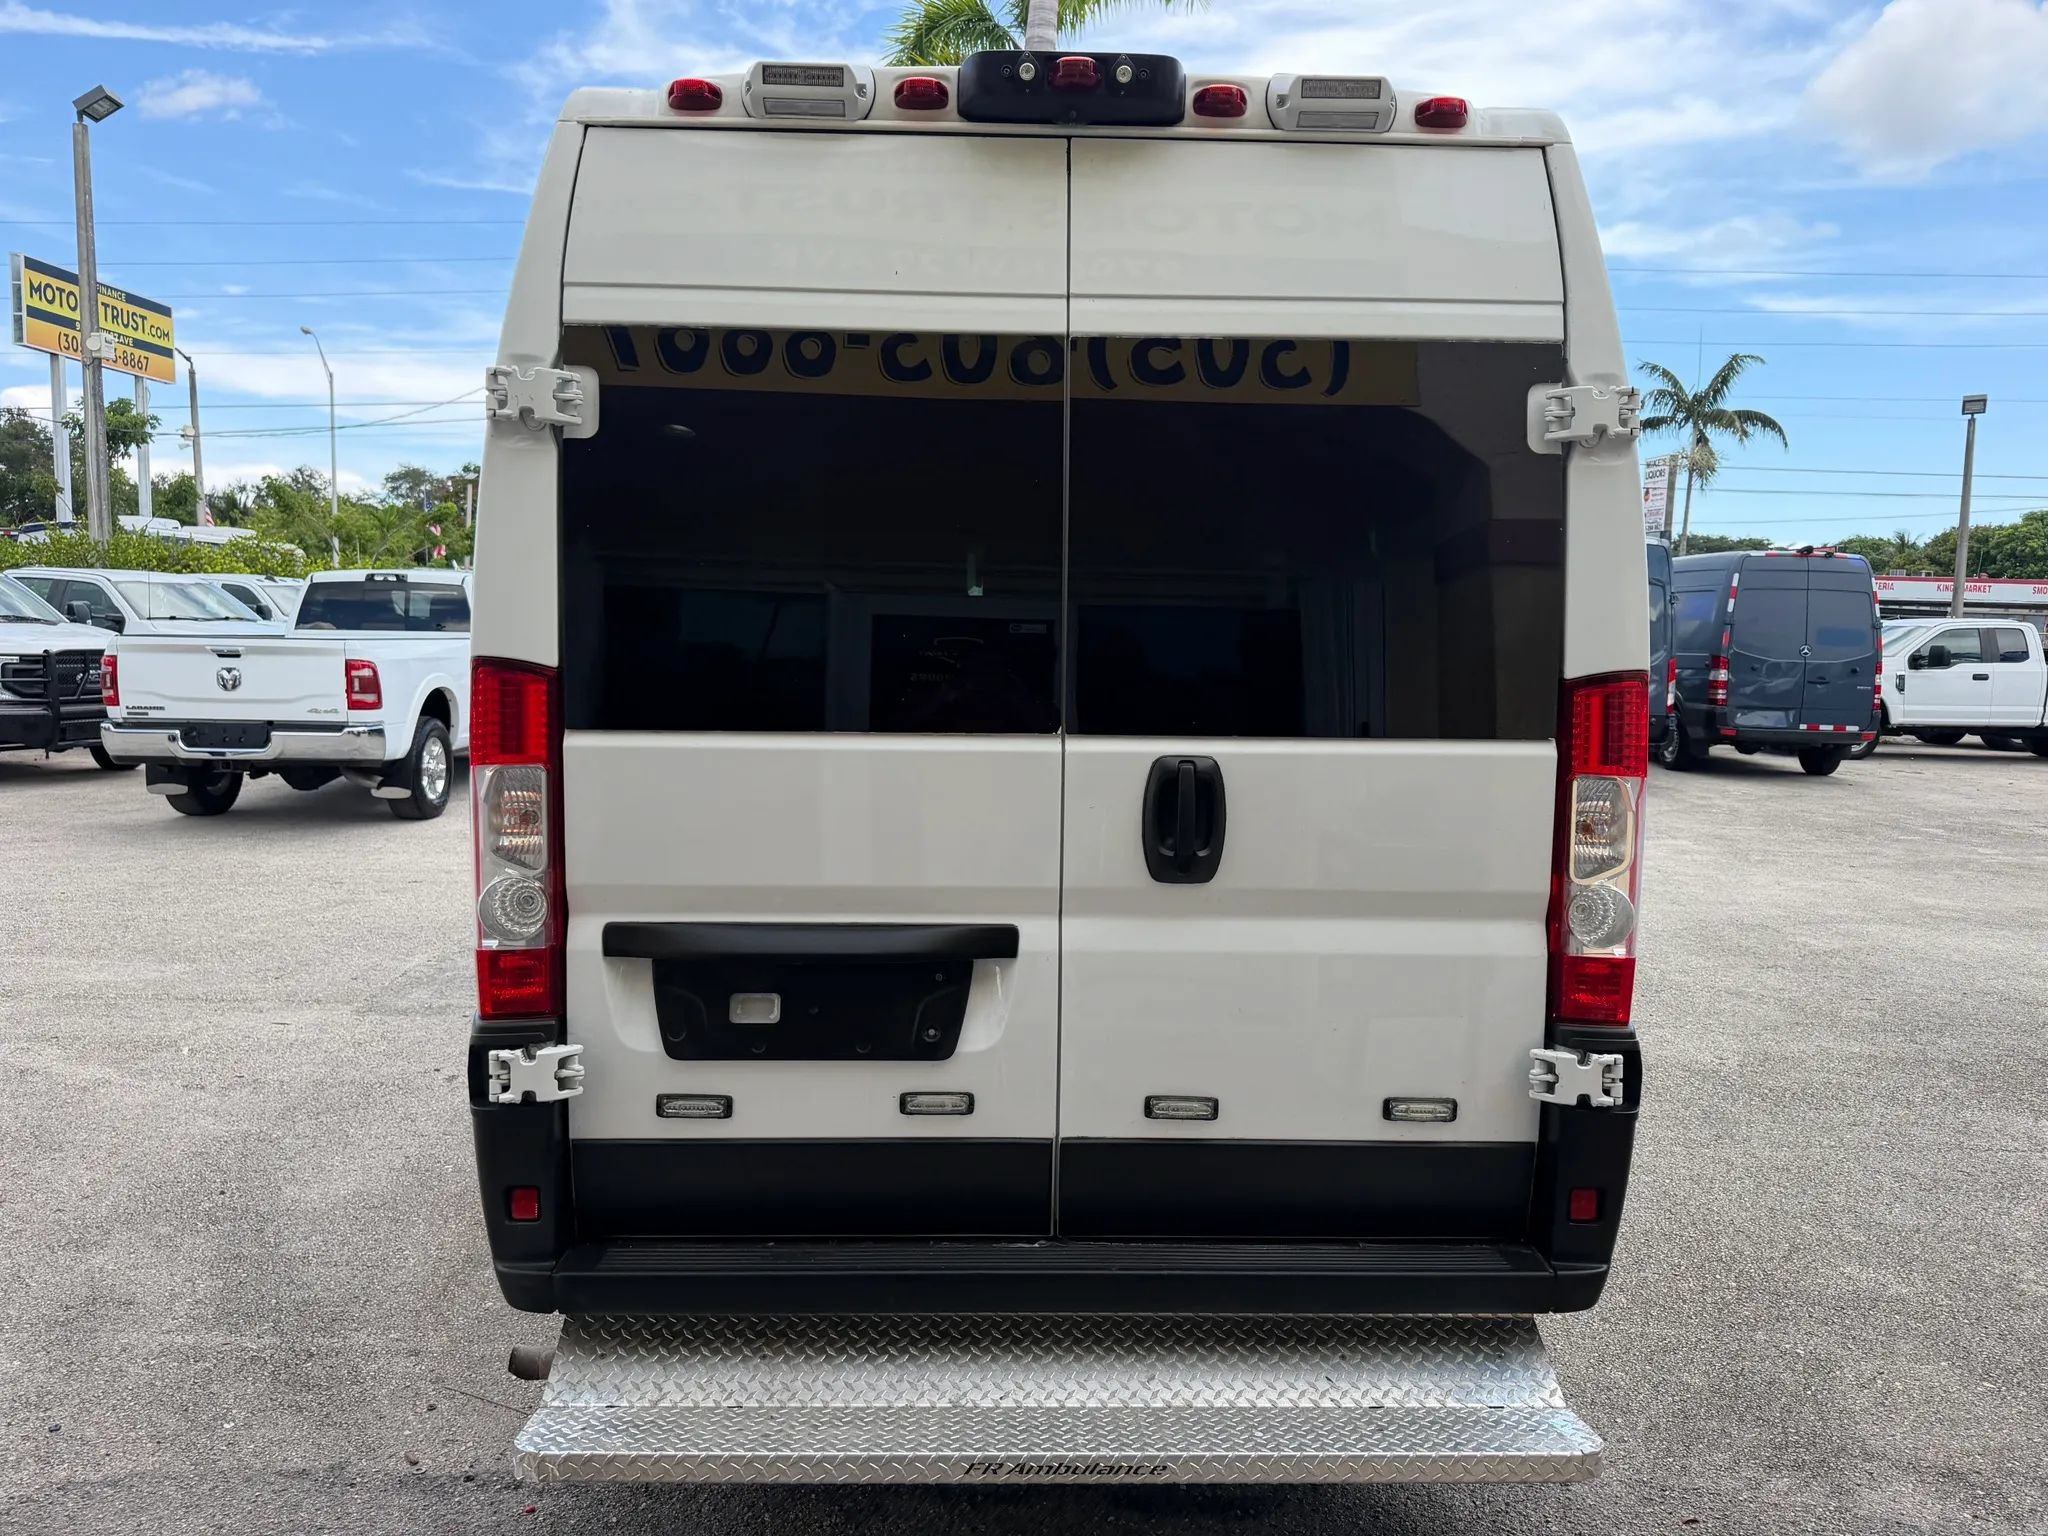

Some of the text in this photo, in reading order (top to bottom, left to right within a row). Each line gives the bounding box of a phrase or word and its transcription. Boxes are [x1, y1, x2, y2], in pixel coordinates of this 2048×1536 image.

[29, 275, 170, 342] MOTO TRUST.COM
[58, 331, 81, 353] (30
[1936, 583, 1955, 593] KING
[963, 1462, 1168, 1475] FR Ambulance
